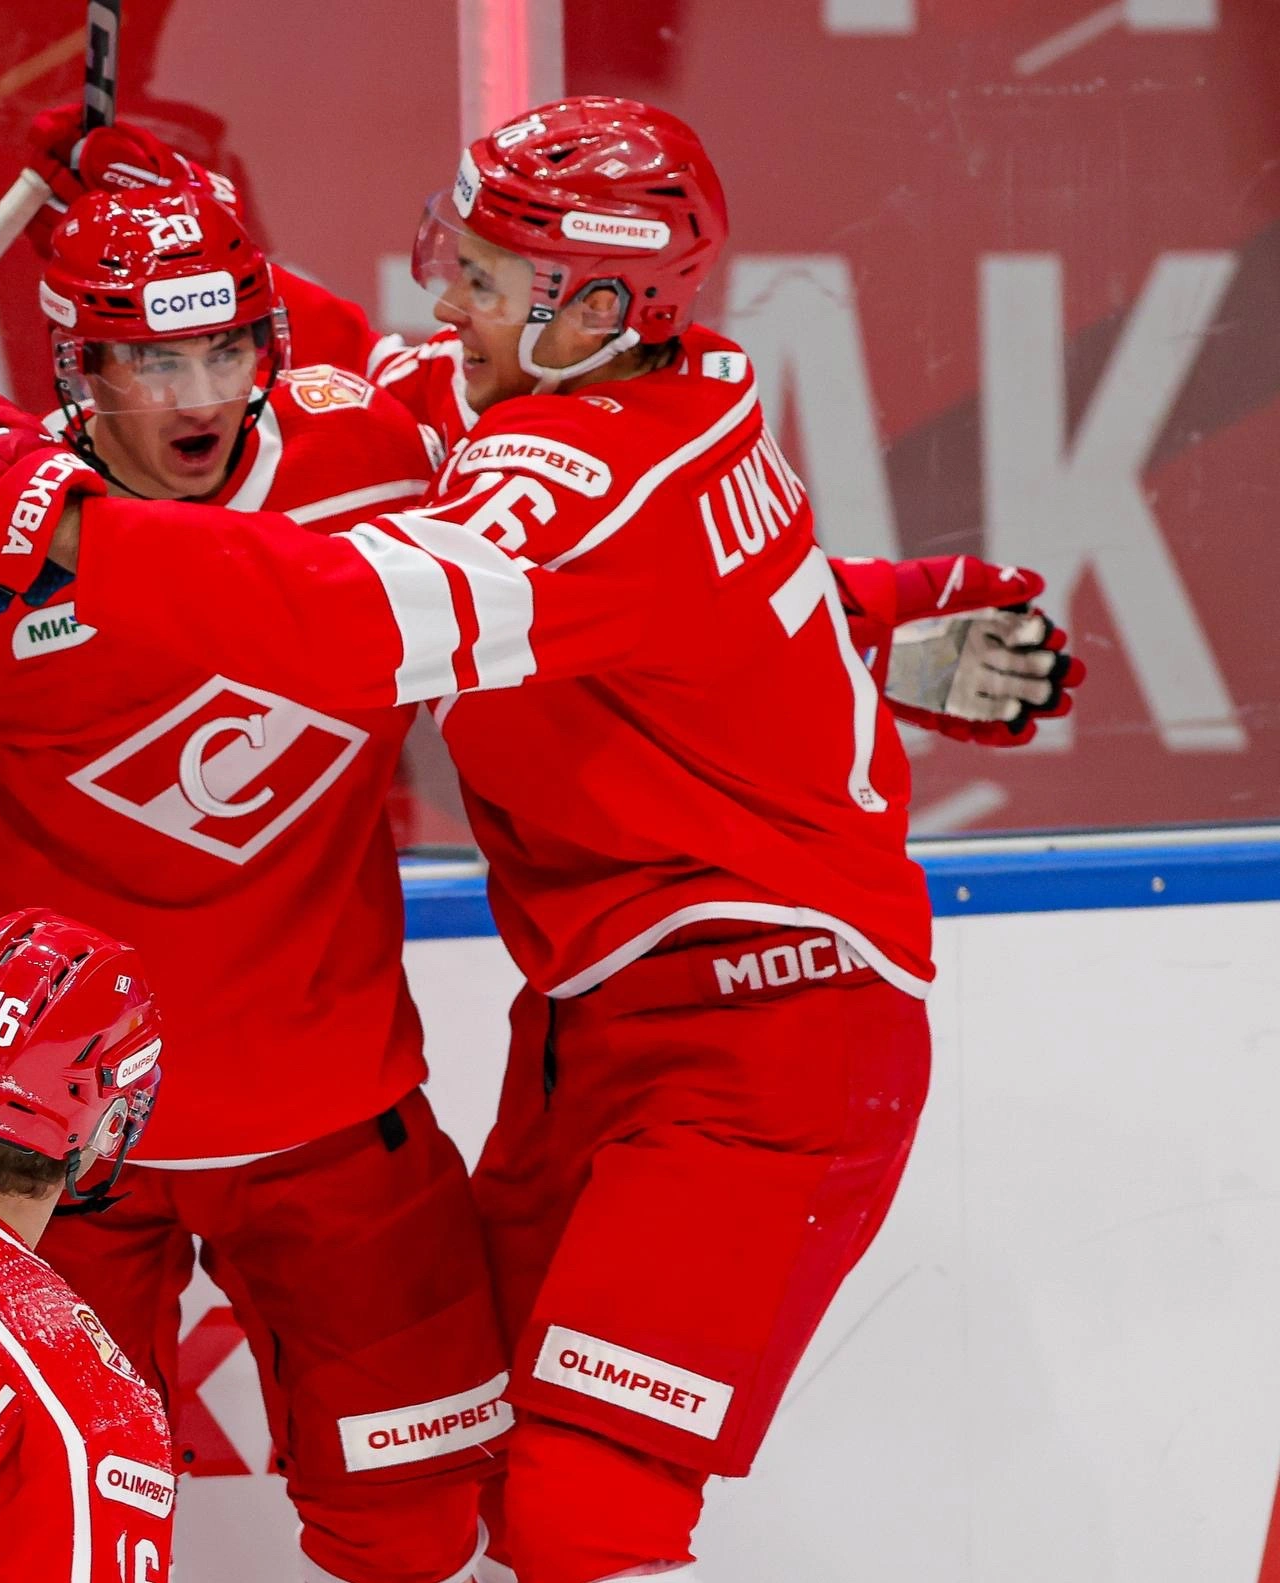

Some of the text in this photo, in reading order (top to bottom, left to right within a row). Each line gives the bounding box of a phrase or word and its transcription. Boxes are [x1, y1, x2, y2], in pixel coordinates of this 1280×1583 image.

[143, 213, 204, 250] 20
[571, 218, 661, 241] OLIMPBET
[149, 287, 232, 316] согаз
[466, 443, 602, 485] OLIMPBET
[768, 544, 889, 813] 7
[121, 1049, 159, 1079] OLIMPBET
[559, 1349, 707, 1414] OLIMPBET
[367, 1399, 500, 1450] OLIMPBET
[107, 1468, 172, 1506] OLIMPBET
